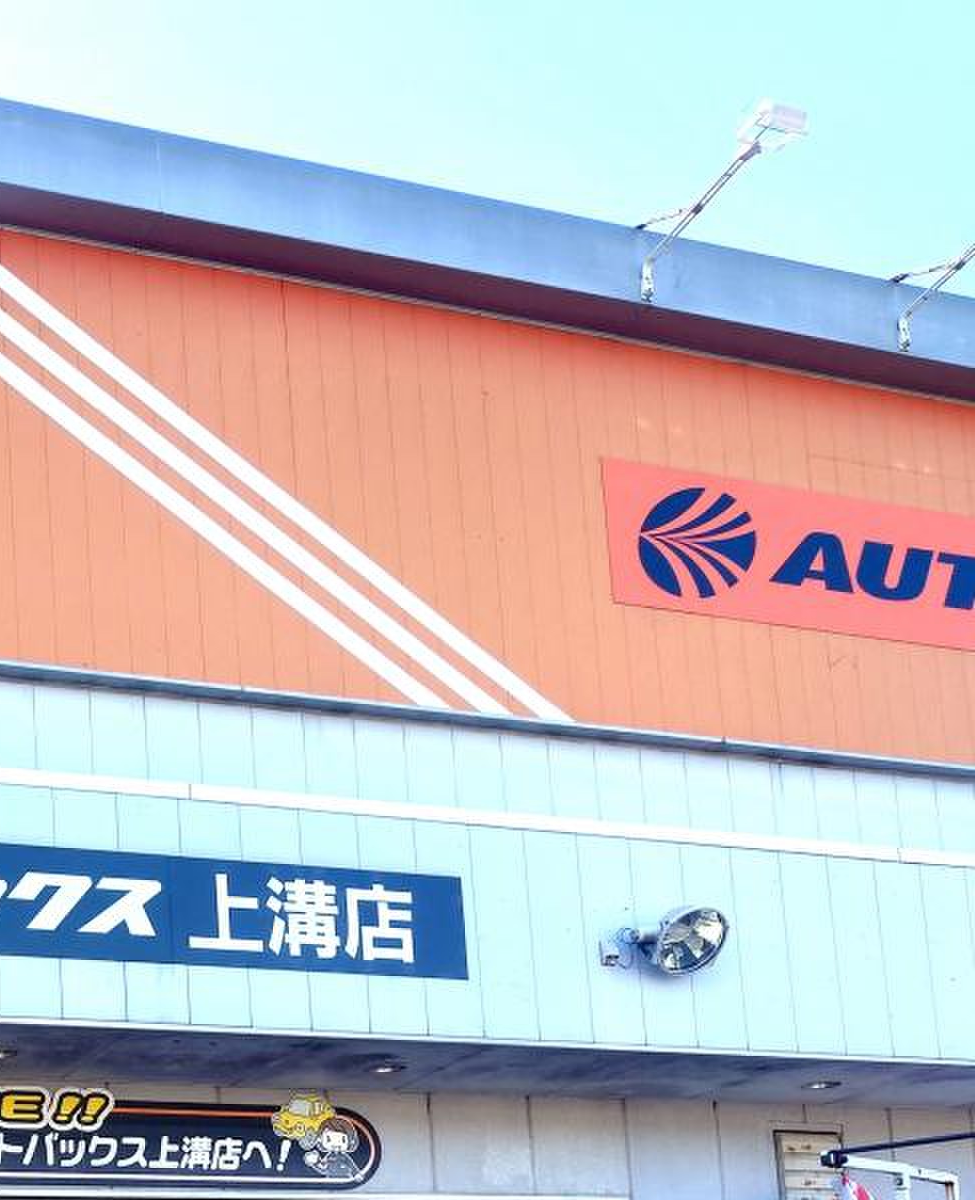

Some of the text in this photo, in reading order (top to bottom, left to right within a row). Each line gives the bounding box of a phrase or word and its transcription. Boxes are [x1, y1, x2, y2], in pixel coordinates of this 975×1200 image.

[769, 530, 975, 610] AUT
[188, 872, 416, 965] 上溝店
